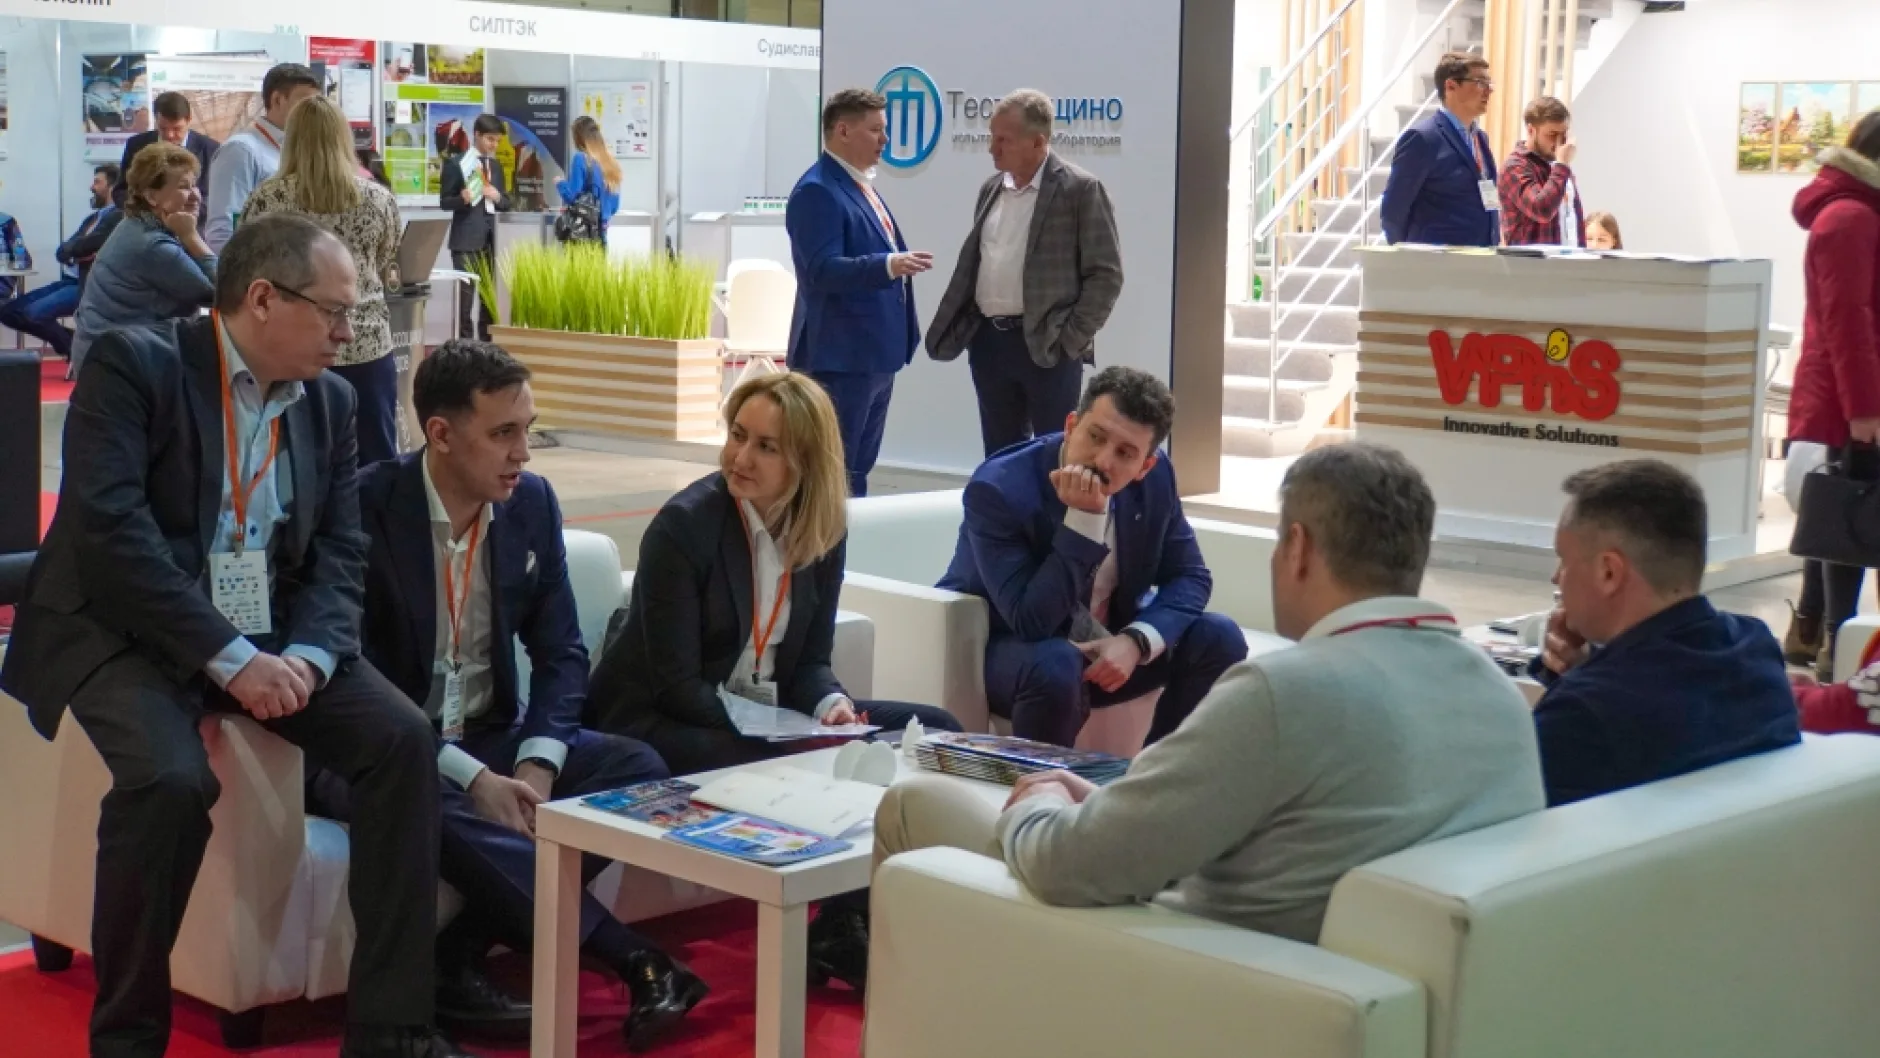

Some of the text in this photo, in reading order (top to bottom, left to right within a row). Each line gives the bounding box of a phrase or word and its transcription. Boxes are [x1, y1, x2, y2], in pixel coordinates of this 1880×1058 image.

[469, 15, 537, 37] СИЛТЭК
[946, 90, 1123, 125] Тес щино
[1051, 132, 1122, 149] аборатория
[1443, 416, 1621, 447] Innovative Solutions
